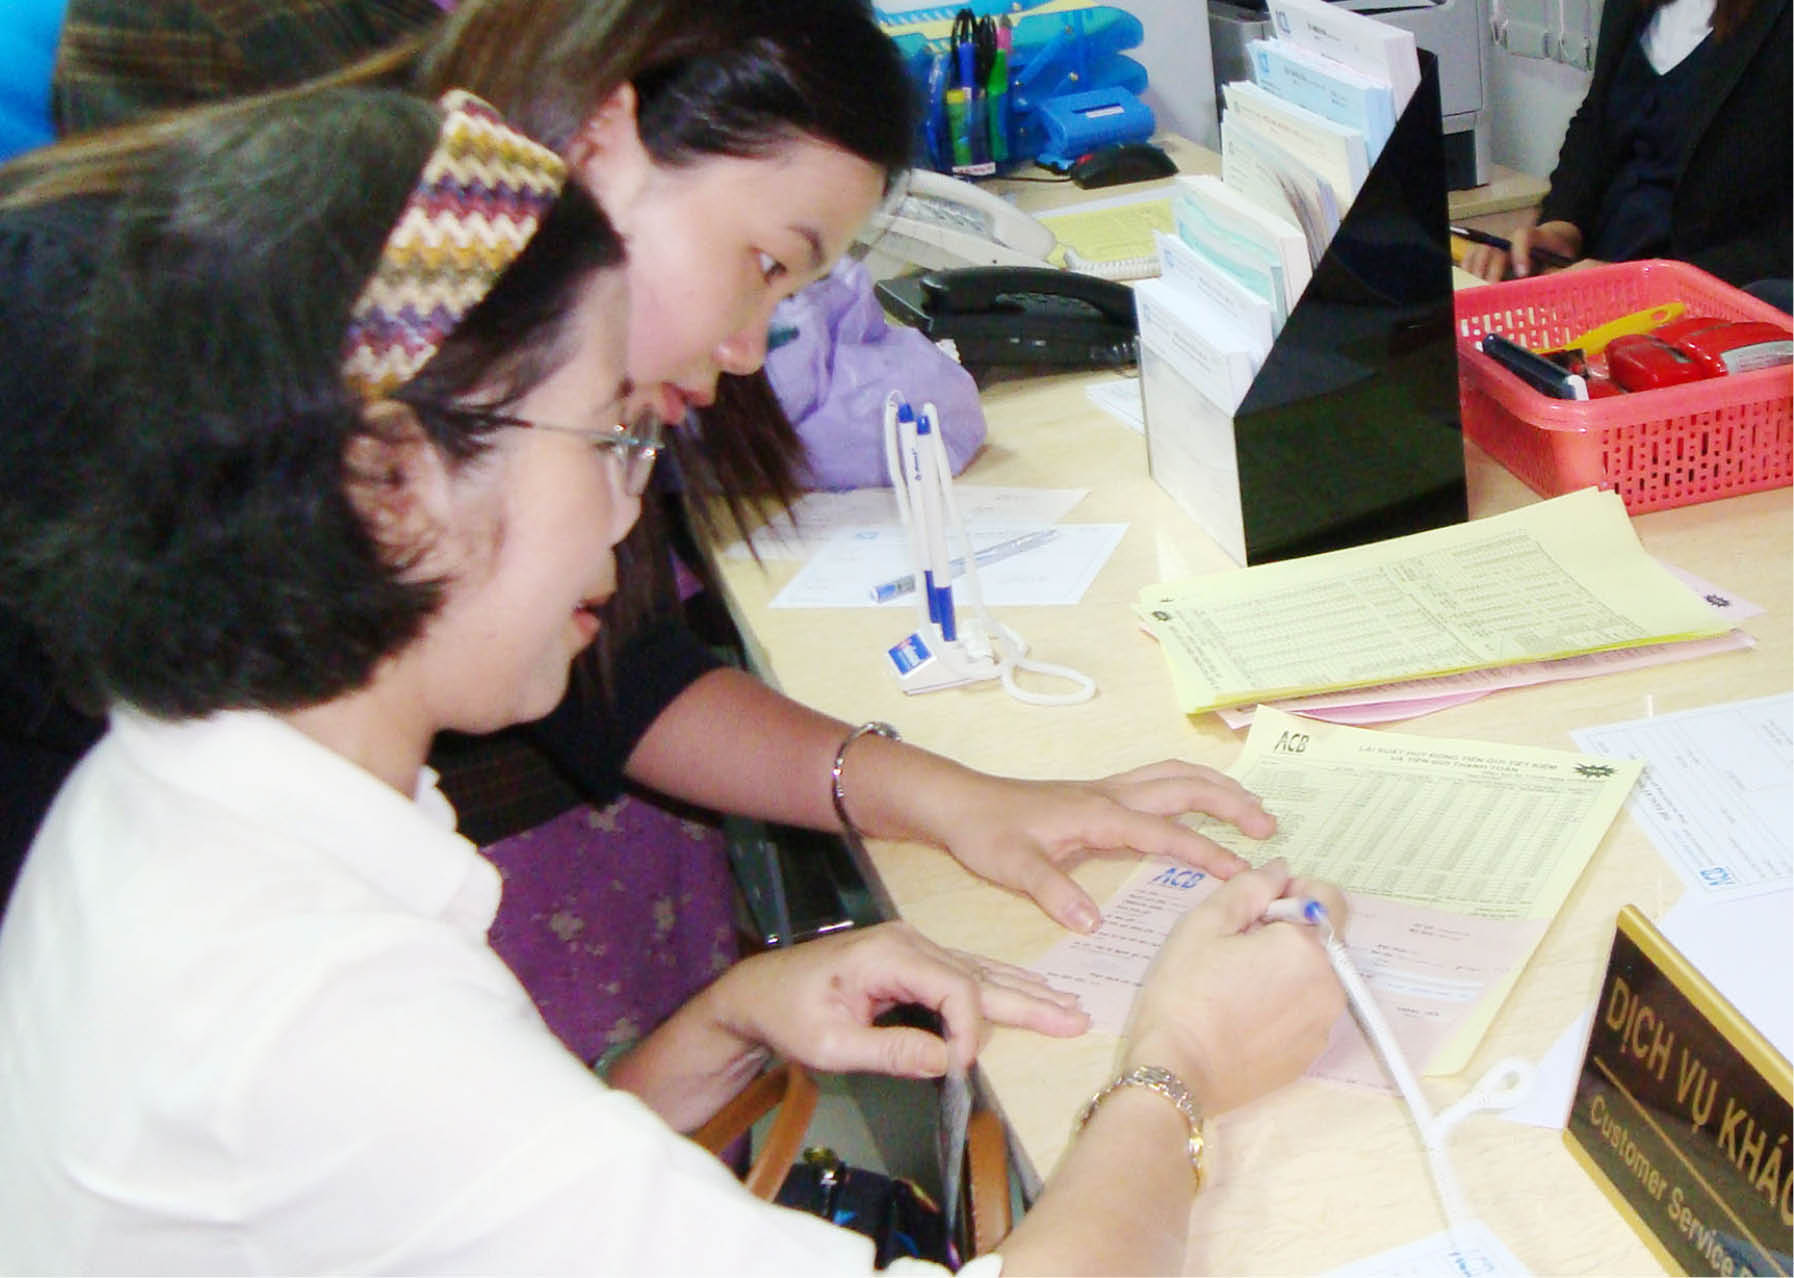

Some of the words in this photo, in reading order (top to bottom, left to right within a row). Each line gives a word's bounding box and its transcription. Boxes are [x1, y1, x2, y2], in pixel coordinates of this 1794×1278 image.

[1273, 731, 1310, 752] ACB
[1152, 867, 1206, 889] ACB
[1606, 976, 1675, 1081] DỊCH
[1677, 1049, 1719, 1133] VỤ
[1589, 1096, 1668, 1202] Customer
[1668, 1187, 1735, 1277] Service
